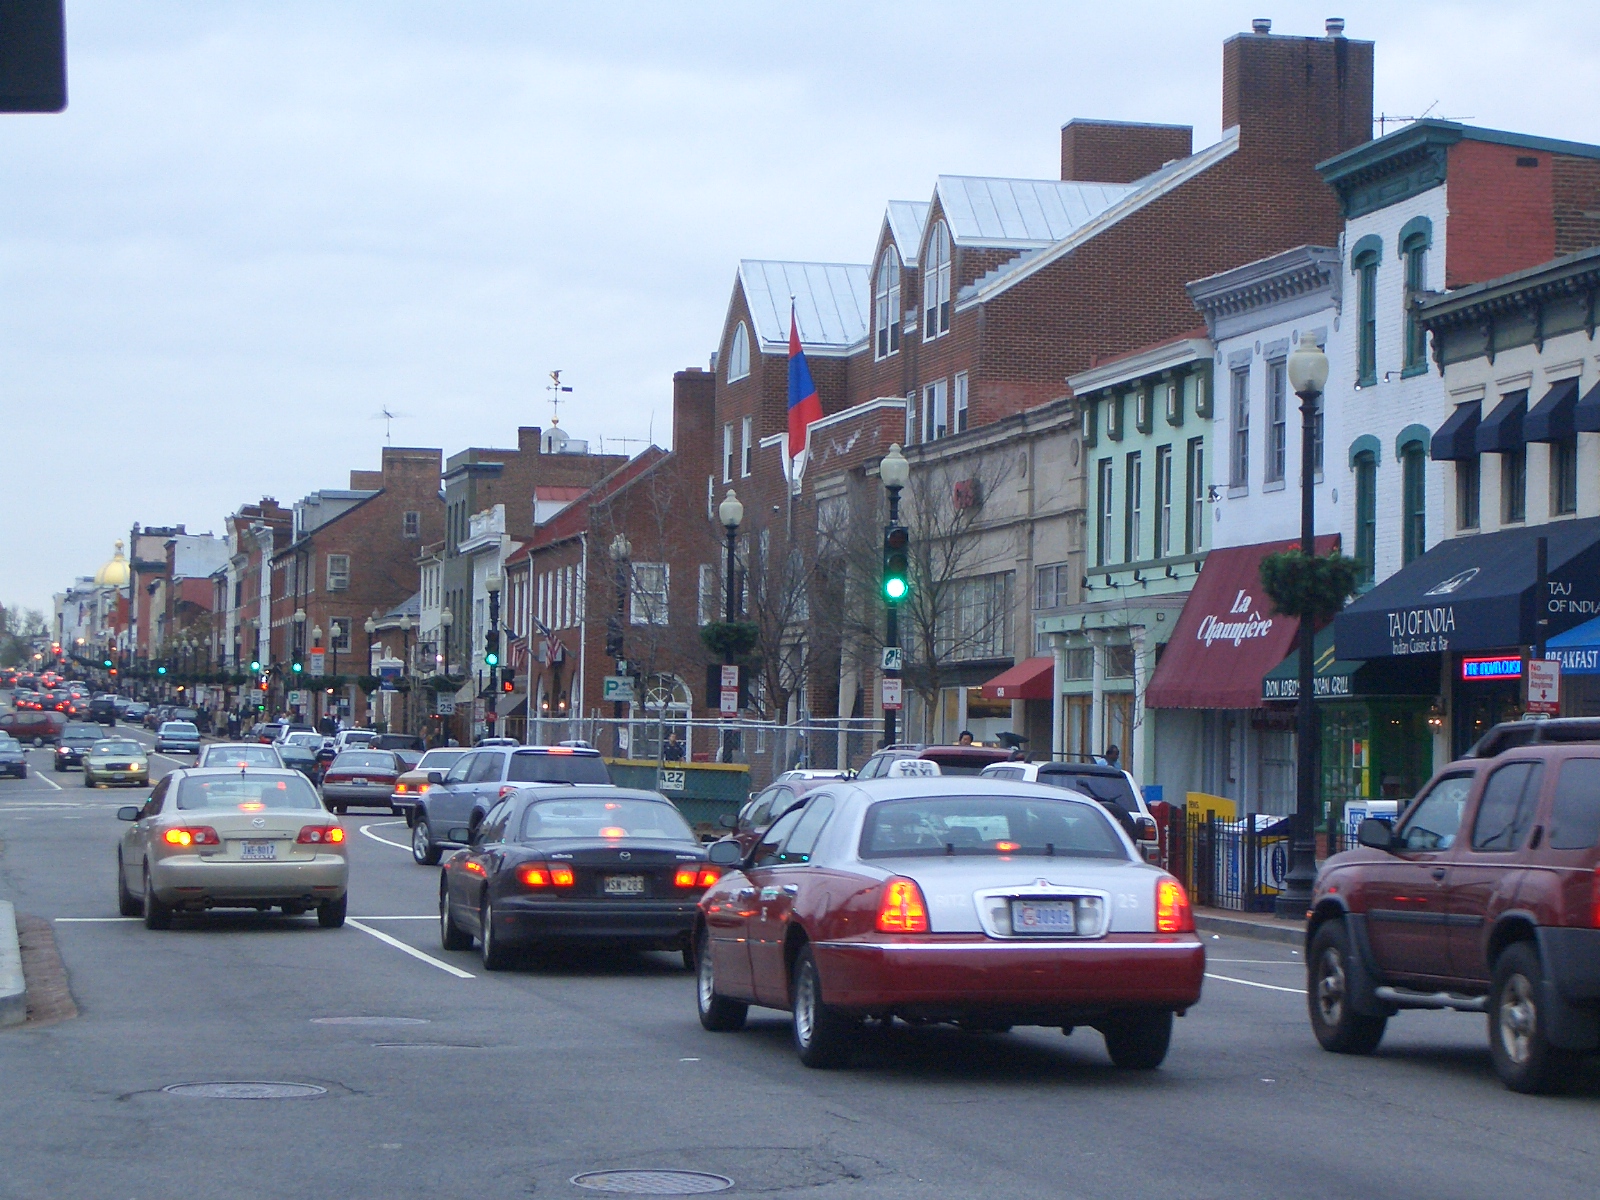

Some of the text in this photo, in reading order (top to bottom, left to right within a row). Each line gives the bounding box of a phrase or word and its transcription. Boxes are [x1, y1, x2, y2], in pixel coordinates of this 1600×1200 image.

[1548, 581, 1572, 595] TAJ
[1230, 589, 1252, 613] La
[1548, 599, 1567, 612] OF
[1197, 611, 1273, 647] Chaumière
[1388, 606, 1455, 637] TAJ OF INDIA
[1265, 680, 1279, 697] DON
[1331, 676, 1349, 695] GRILL
[440, 703, 452, 713] 25
